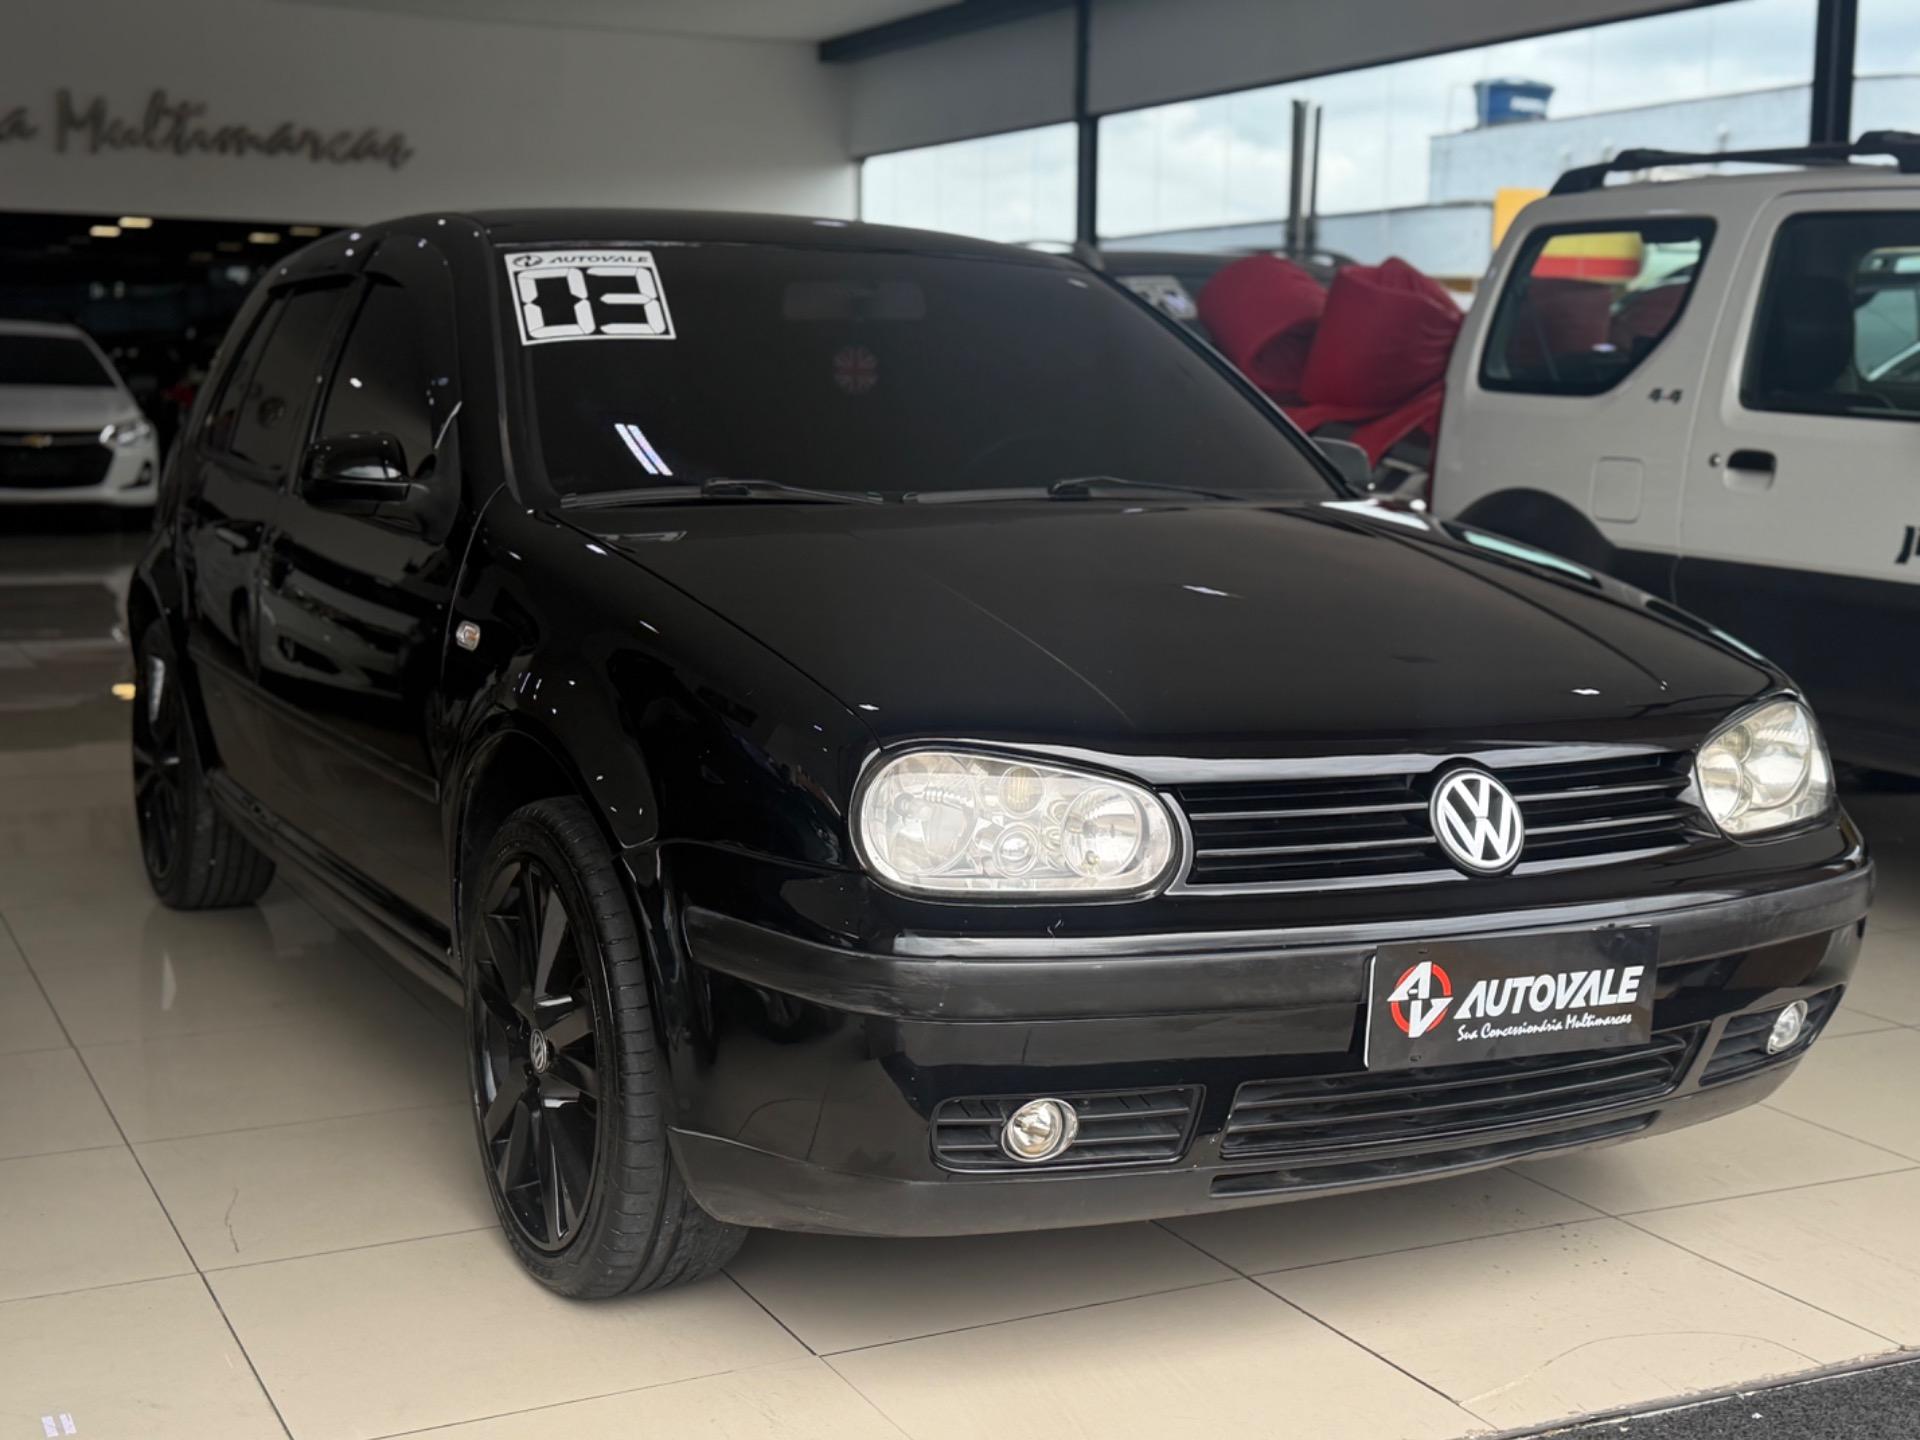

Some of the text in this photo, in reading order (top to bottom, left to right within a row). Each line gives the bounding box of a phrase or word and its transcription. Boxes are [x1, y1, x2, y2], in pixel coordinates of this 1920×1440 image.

[54, 86, 414, 170] Multimarcas
[549, 255, 650, 264] AUTOVALE
[517, 267, 666, 339] 03
[1435, 771, 1522, 870] VW
[1453, 966, 1645, 1019] AUTOVALE
[1456, 1011, 1633, 1042] Sua Concessionária Multimarcas
